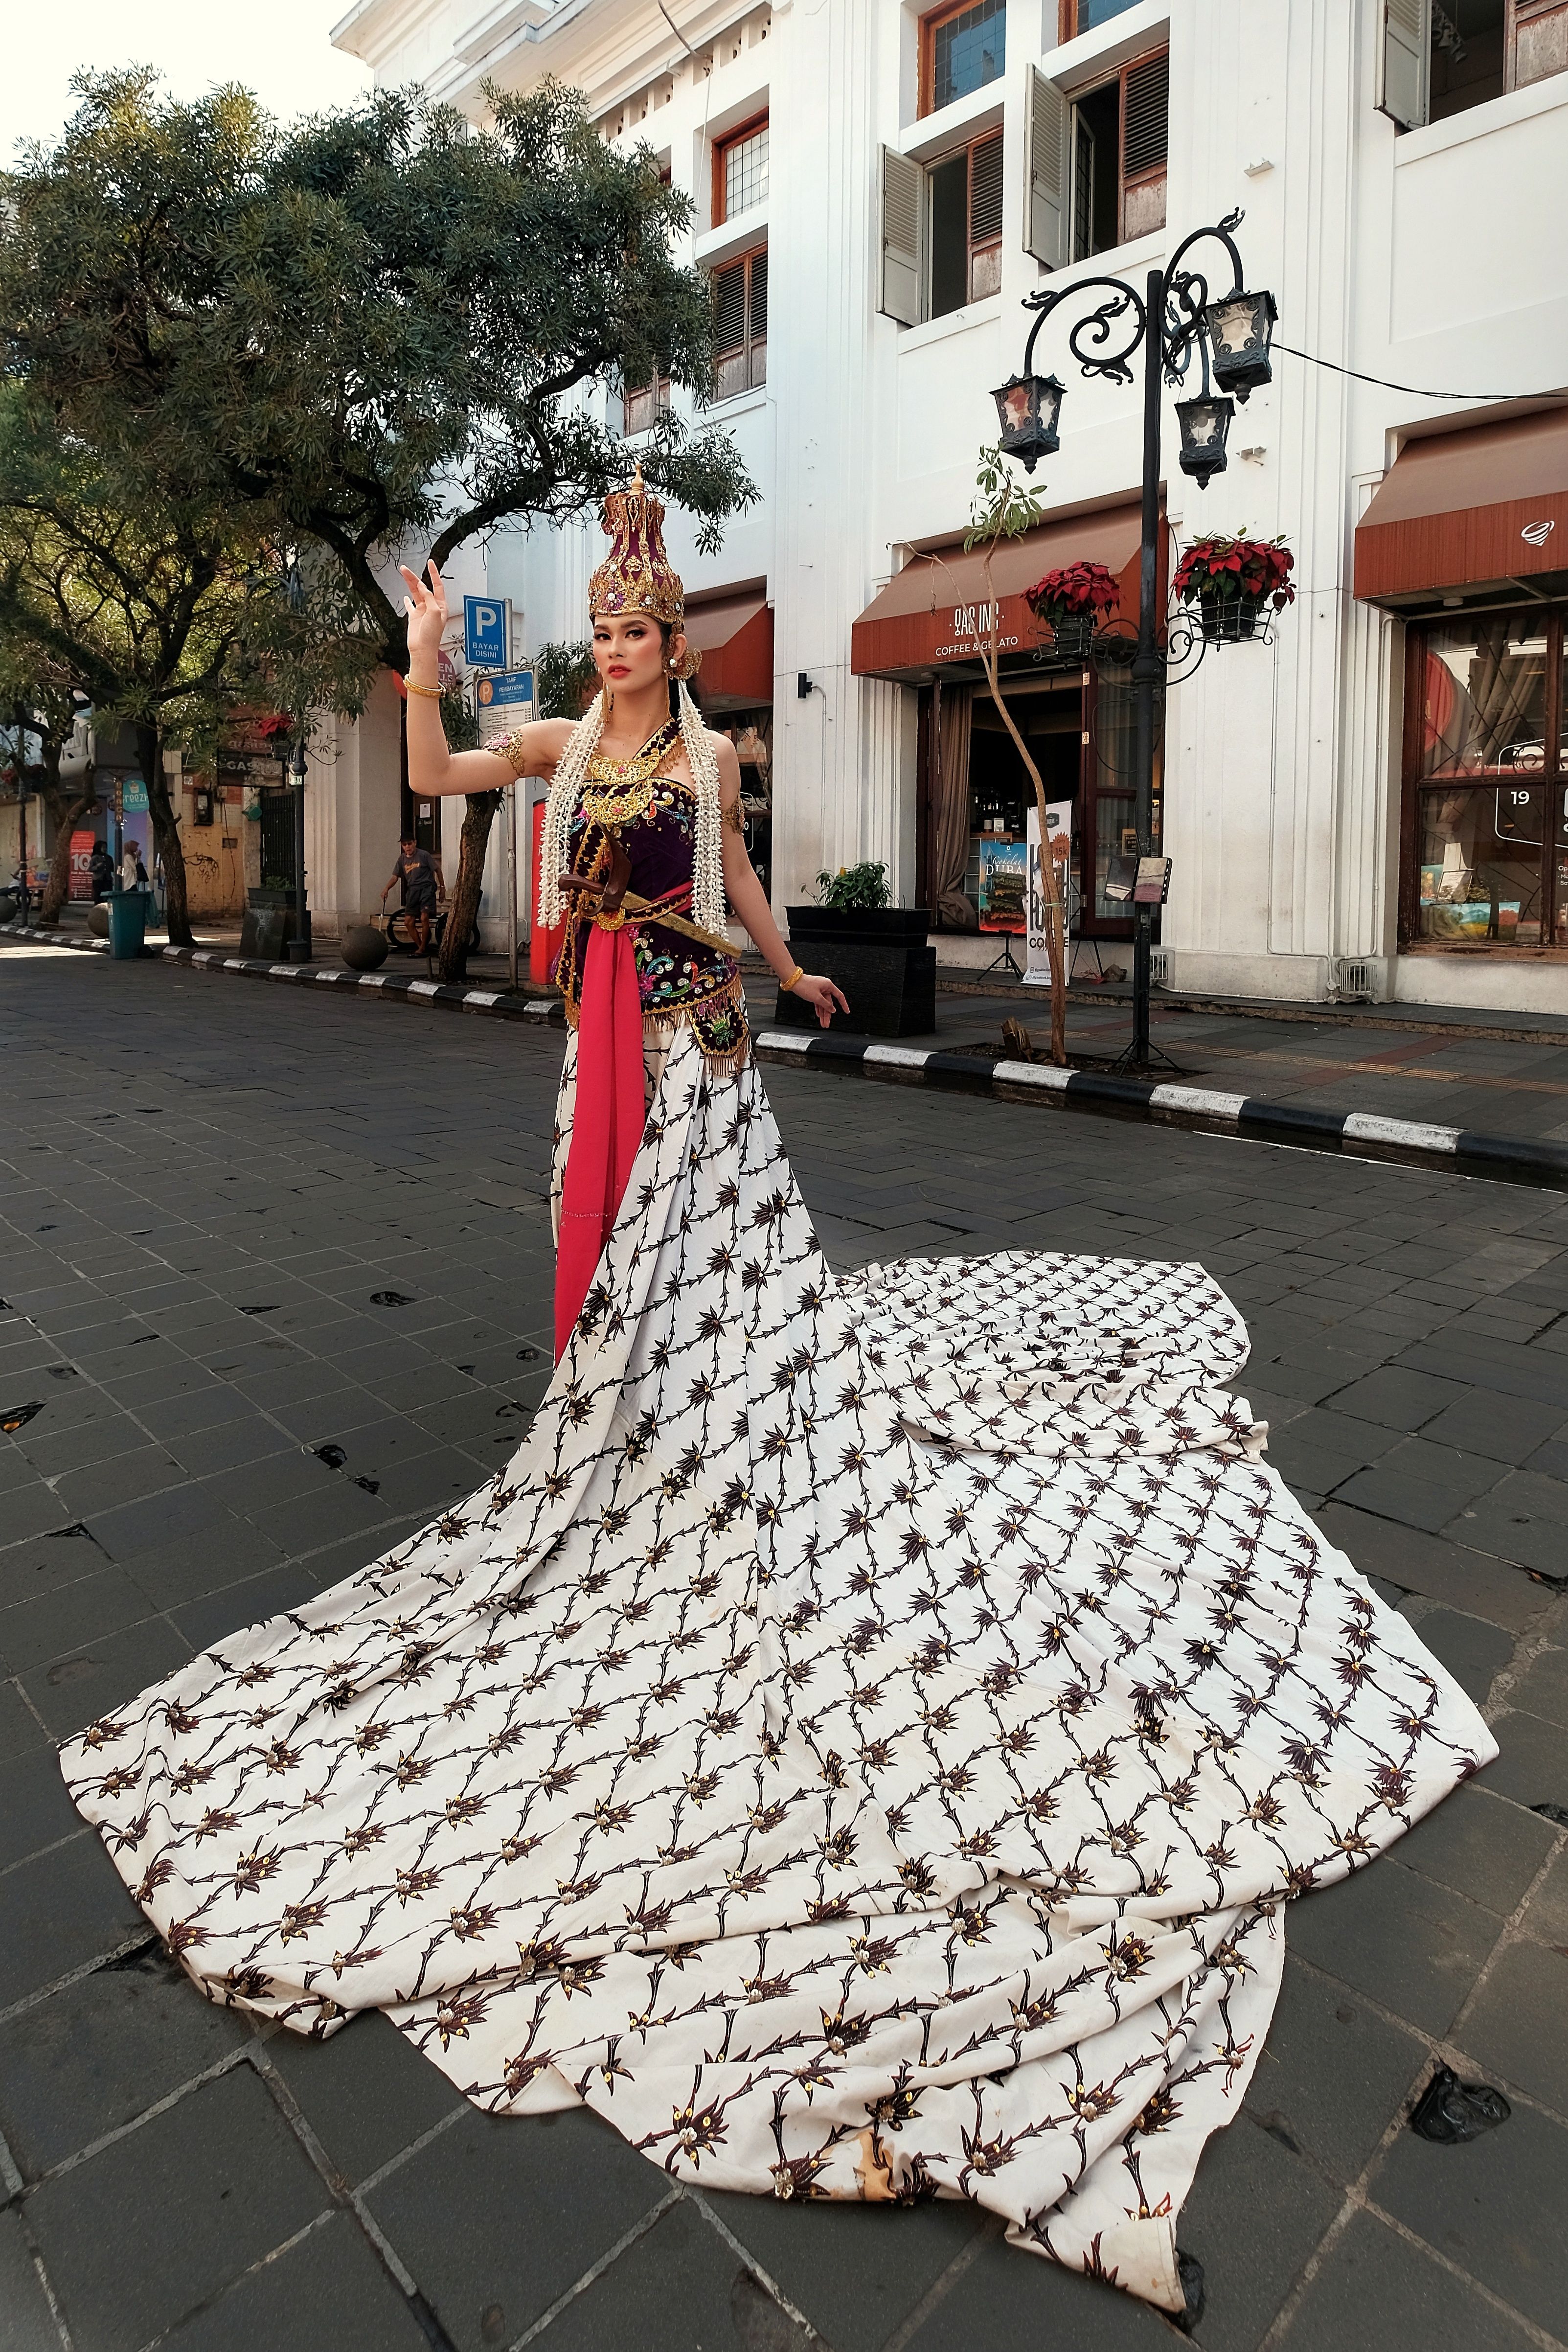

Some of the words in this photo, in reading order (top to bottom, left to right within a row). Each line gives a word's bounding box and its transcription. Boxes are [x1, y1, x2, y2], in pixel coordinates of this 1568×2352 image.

[476, 606, 497, 637] P
[473, 642, 499, 651] BAYAR
[935, 643, 970, 656] COFFEE
[981, 636, 1018, 650] GEATO
[476, 650, 497, 659] DISINI
[483, 685, 490, 701] P
[499, 684, 524, 693] PEMBAYARAN
[1510, 791, 1530, 805] 19
[1056, 845, 1068, 856] 15k
[71, 853, 92, 871] 10
[993, 853, 1022, 866] Cokelat
[985, 864, 1024, 875] DUBA
[1029, 936, 1069, 949] COE
